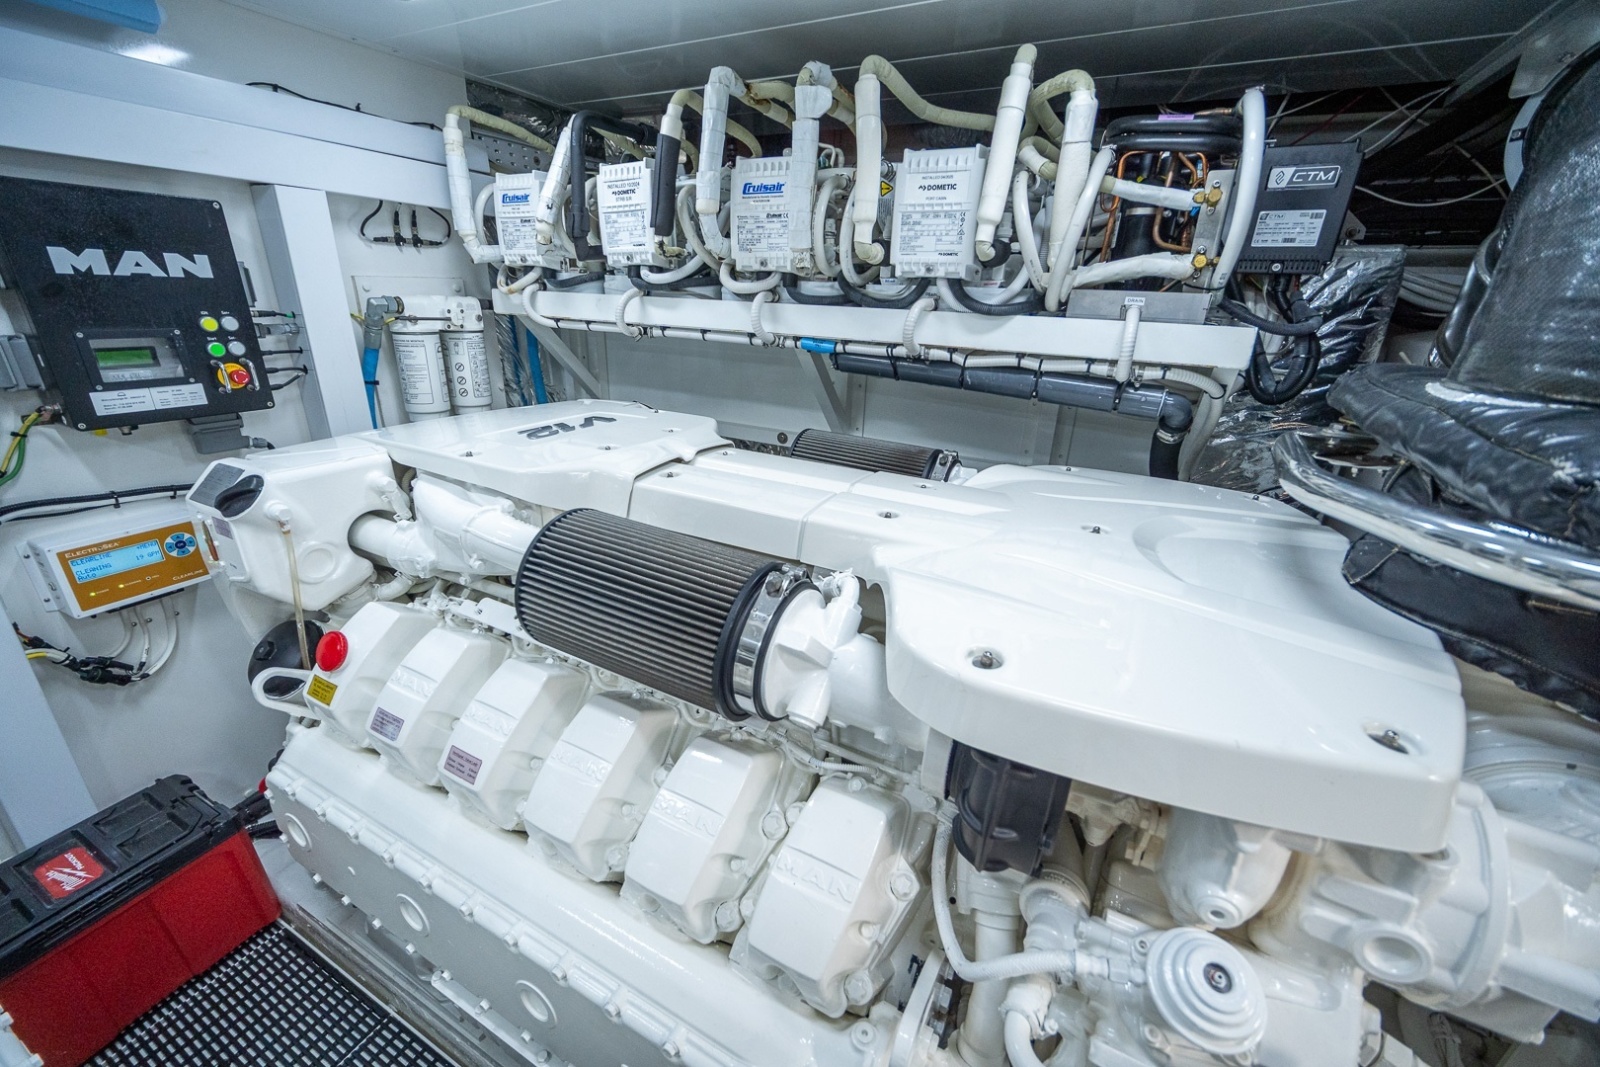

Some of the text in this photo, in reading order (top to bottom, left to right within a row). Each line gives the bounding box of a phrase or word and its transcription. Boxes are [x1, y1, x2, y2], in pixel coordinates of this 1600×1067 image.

[1292, 170, 1336, 182] CTM
[742, 182, 785, 195] Cruisair
[927, 183, 957, 191] DOMETIC
[501, 193, 530, 204] Cruisair
[46, 246, 214, 279] MAN
[70, 552, 113, 567] CLEARLINE
[148, 550, 161, 559] GPM
[75, 562, 113, 576] CLEANING
[77, 572, 97, 582] Auto
[654, 792, 721, 837] MAN
[776, 851, 855, 904] MAN
